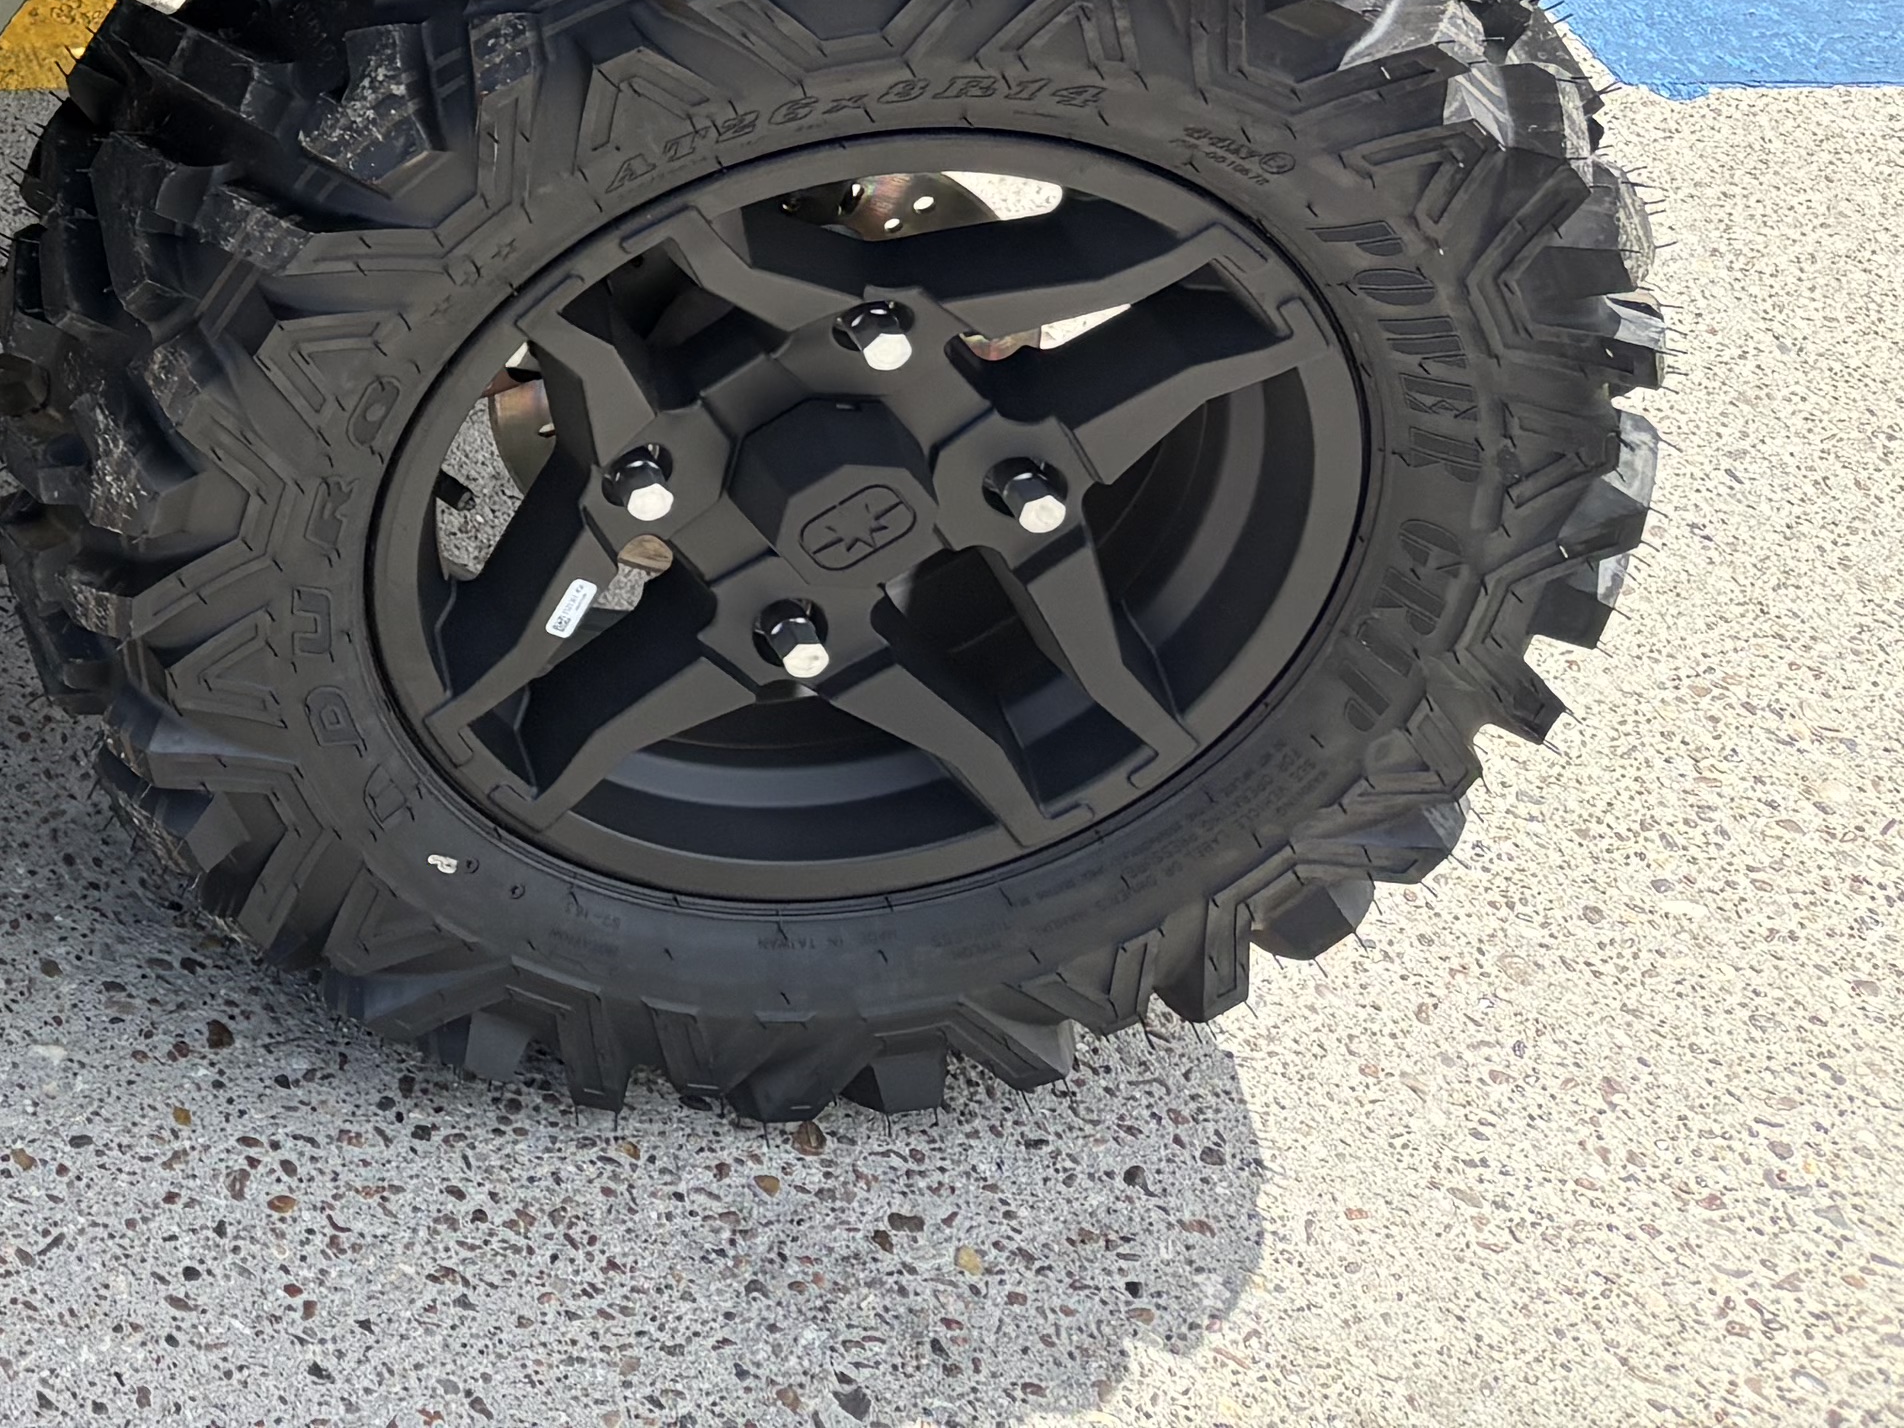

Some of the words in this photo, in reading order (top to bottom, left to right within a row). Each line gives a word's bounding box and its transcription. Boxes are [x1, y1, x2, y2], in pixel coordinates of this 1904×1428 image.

[1306, 219, 1483, 484] POWER
[291, 376, 400, 748] DURO
[1338, 518, 1470, 733] GRIP
